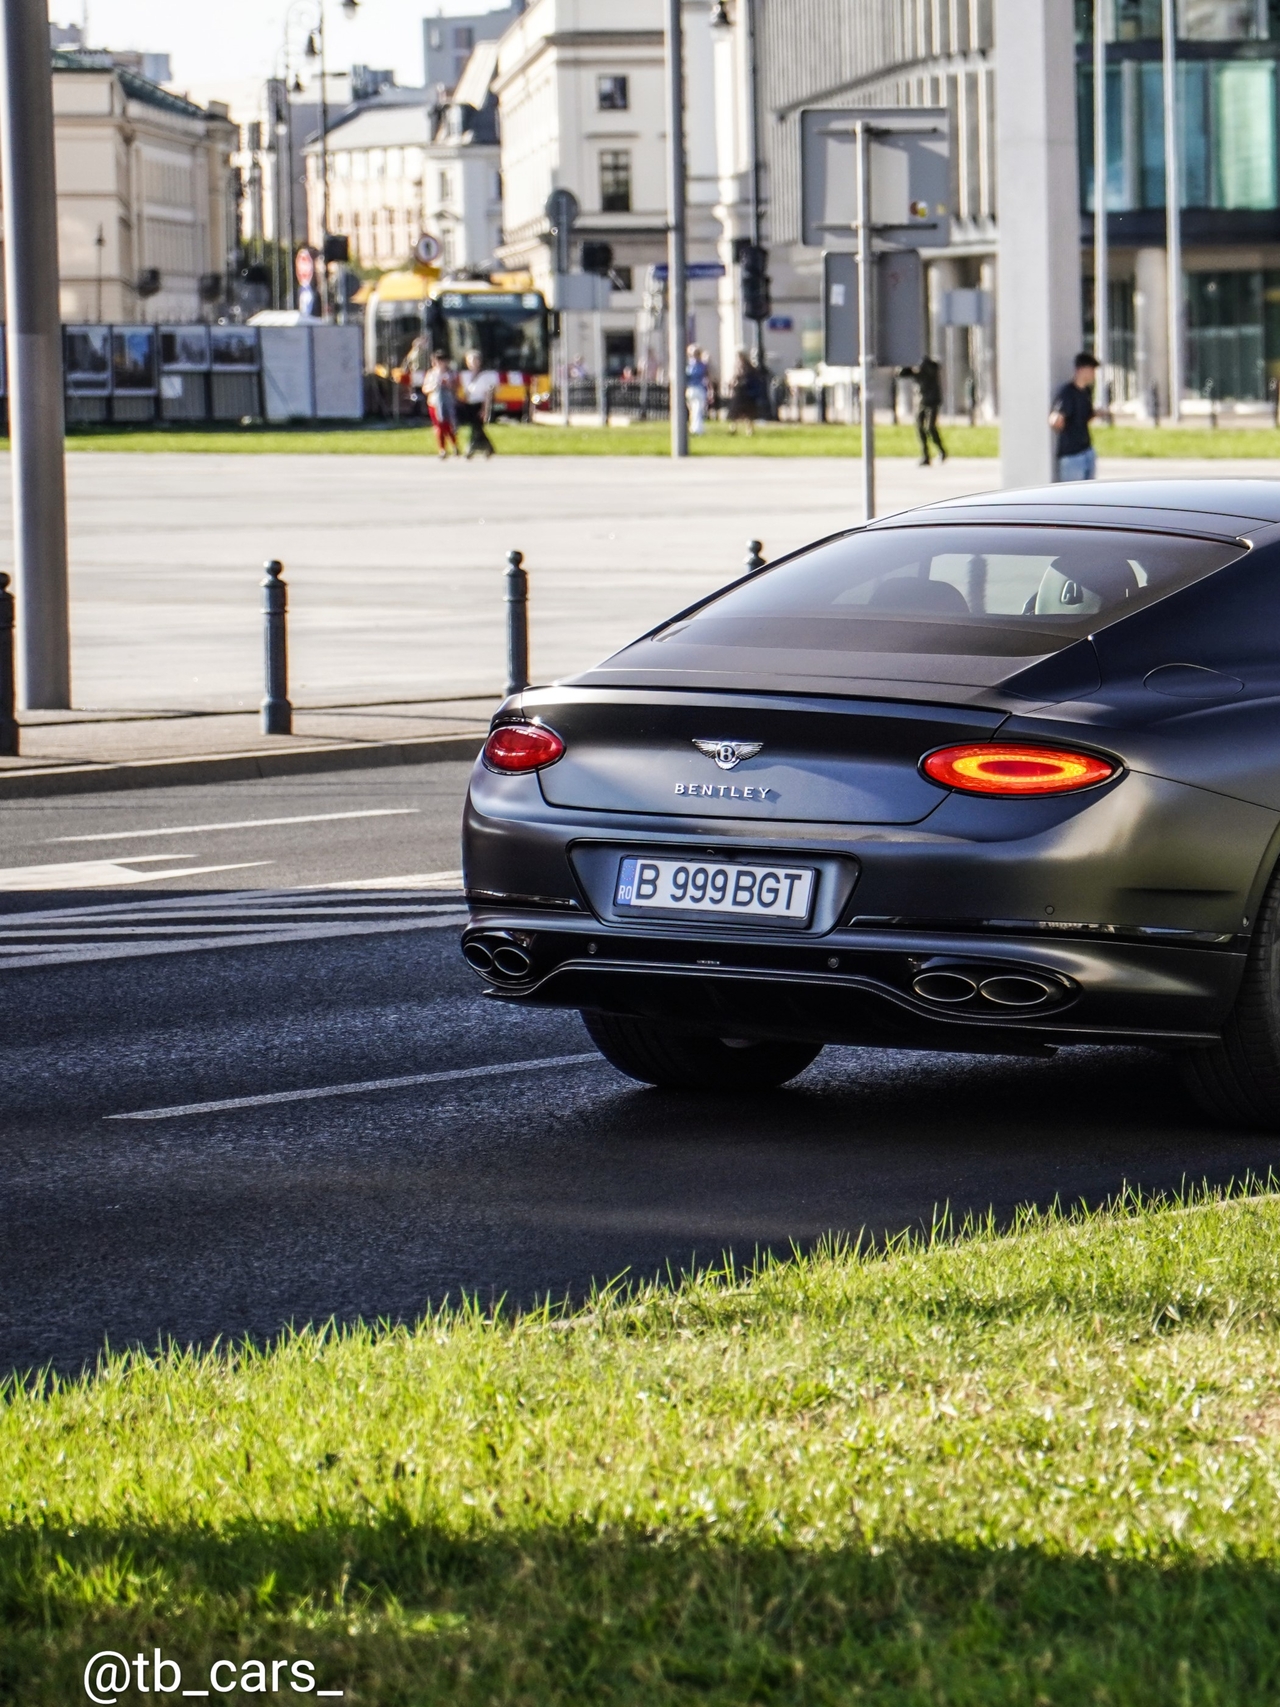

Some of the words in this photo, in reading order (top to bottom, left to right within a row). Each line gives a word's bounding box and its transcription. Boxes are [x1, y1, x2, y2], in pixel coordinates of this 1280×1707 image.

[674, 783, 771, 799] BENTLEY
[635, 863, 660, 901] B
[617, 886, 633, 900] RO
